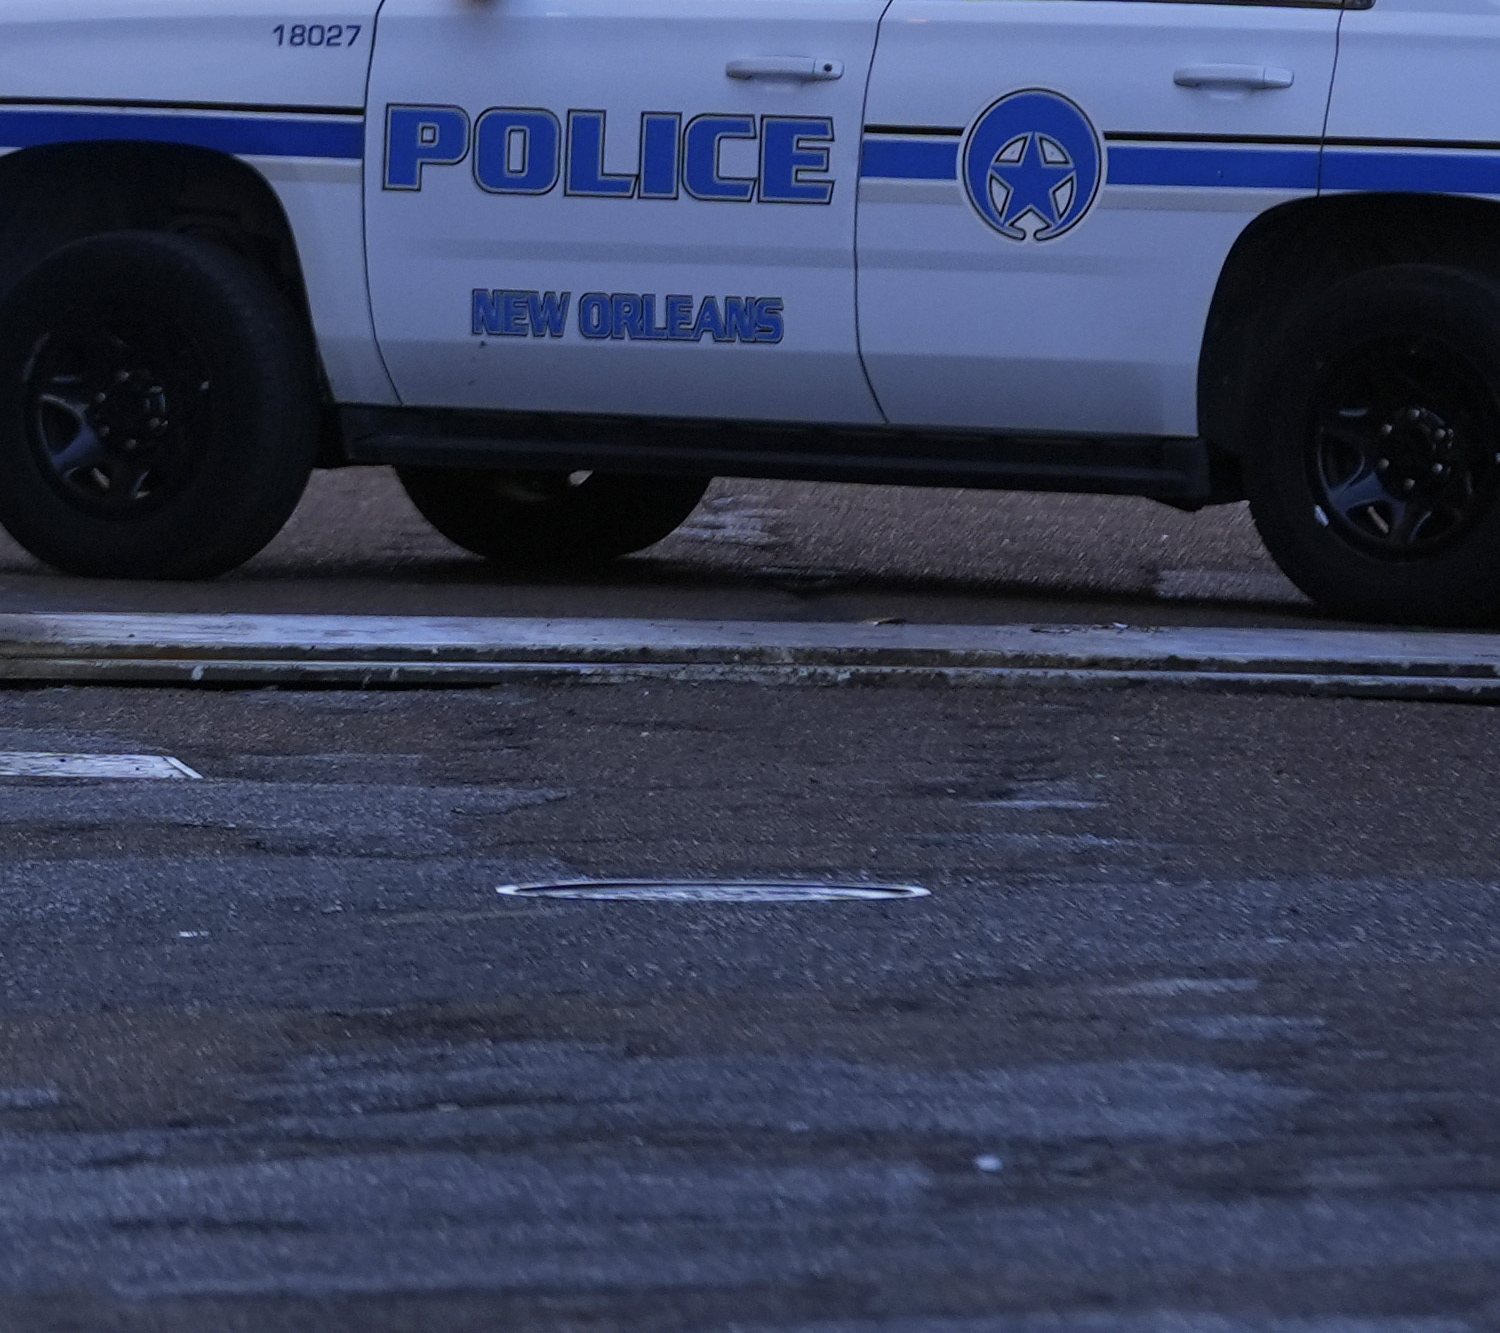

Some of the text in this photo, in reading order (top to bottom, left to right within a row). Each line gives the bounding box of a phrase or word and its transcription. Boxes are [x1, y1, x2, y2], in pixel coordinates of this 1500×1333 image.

[272, 23, 362, 47] 18027
[381, 102, 836, 205] POLICE
[471, 287, 786, 345] NEW ORLEANS
